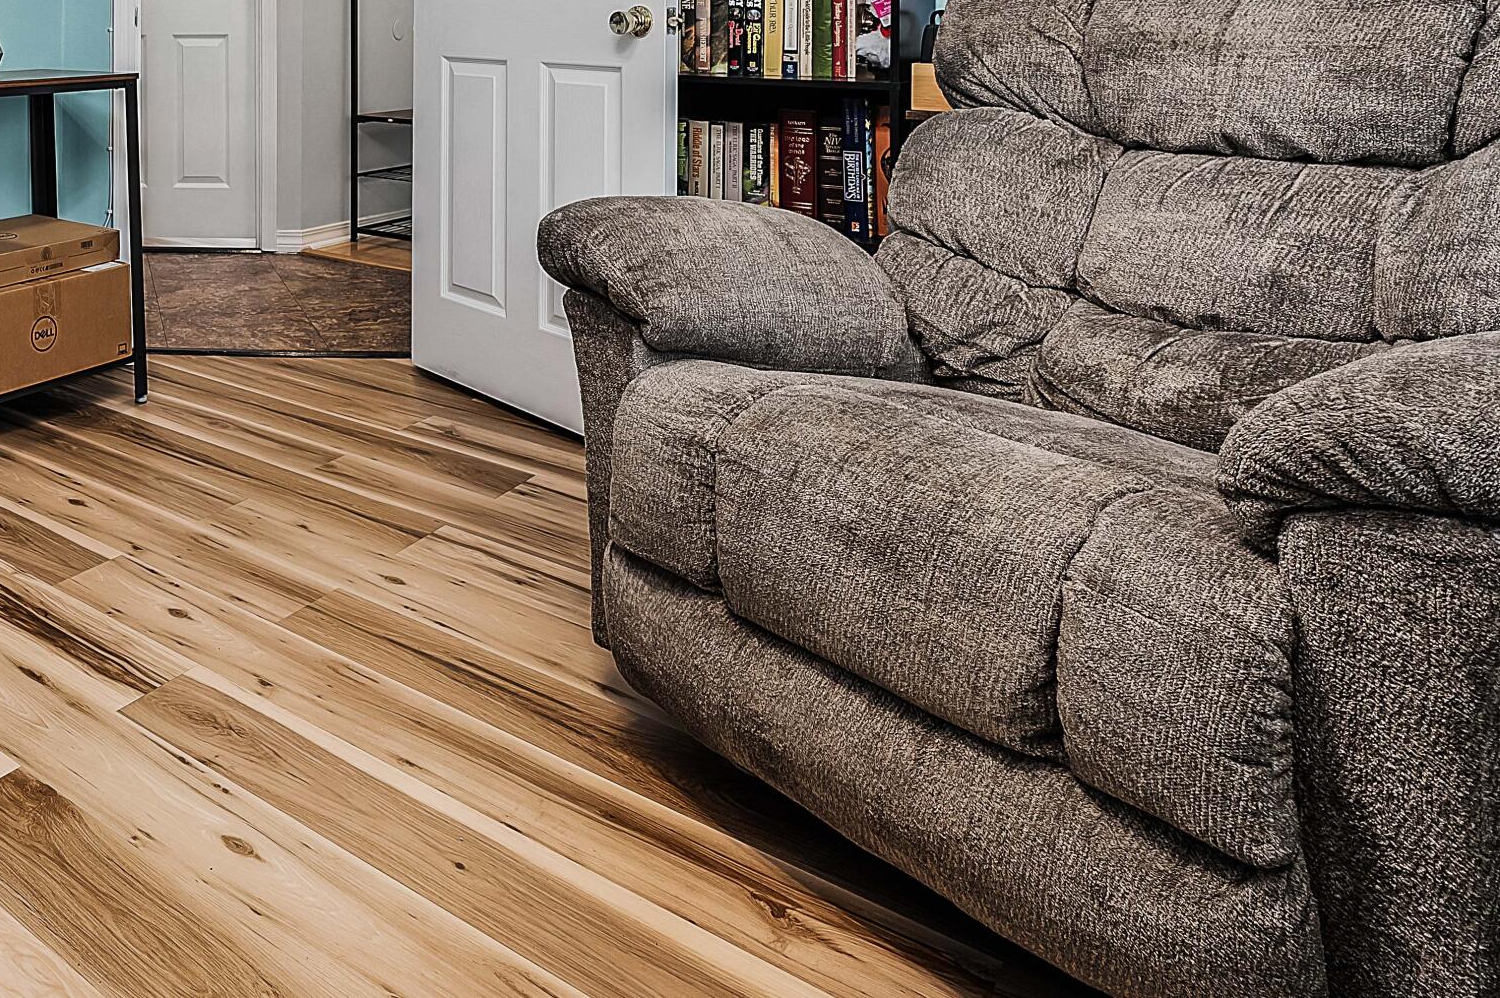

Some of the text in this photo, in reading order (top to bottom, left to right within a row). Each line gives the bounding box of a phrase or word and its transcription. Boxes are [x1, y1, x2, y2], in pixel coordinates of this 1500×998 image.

[692, 127, 702, 149] Riddle
[692, 159, 702, 177] Stars
[845, 153, 856, 199] BIRTHDAYS
[34, 330, 54, 341] DELL
